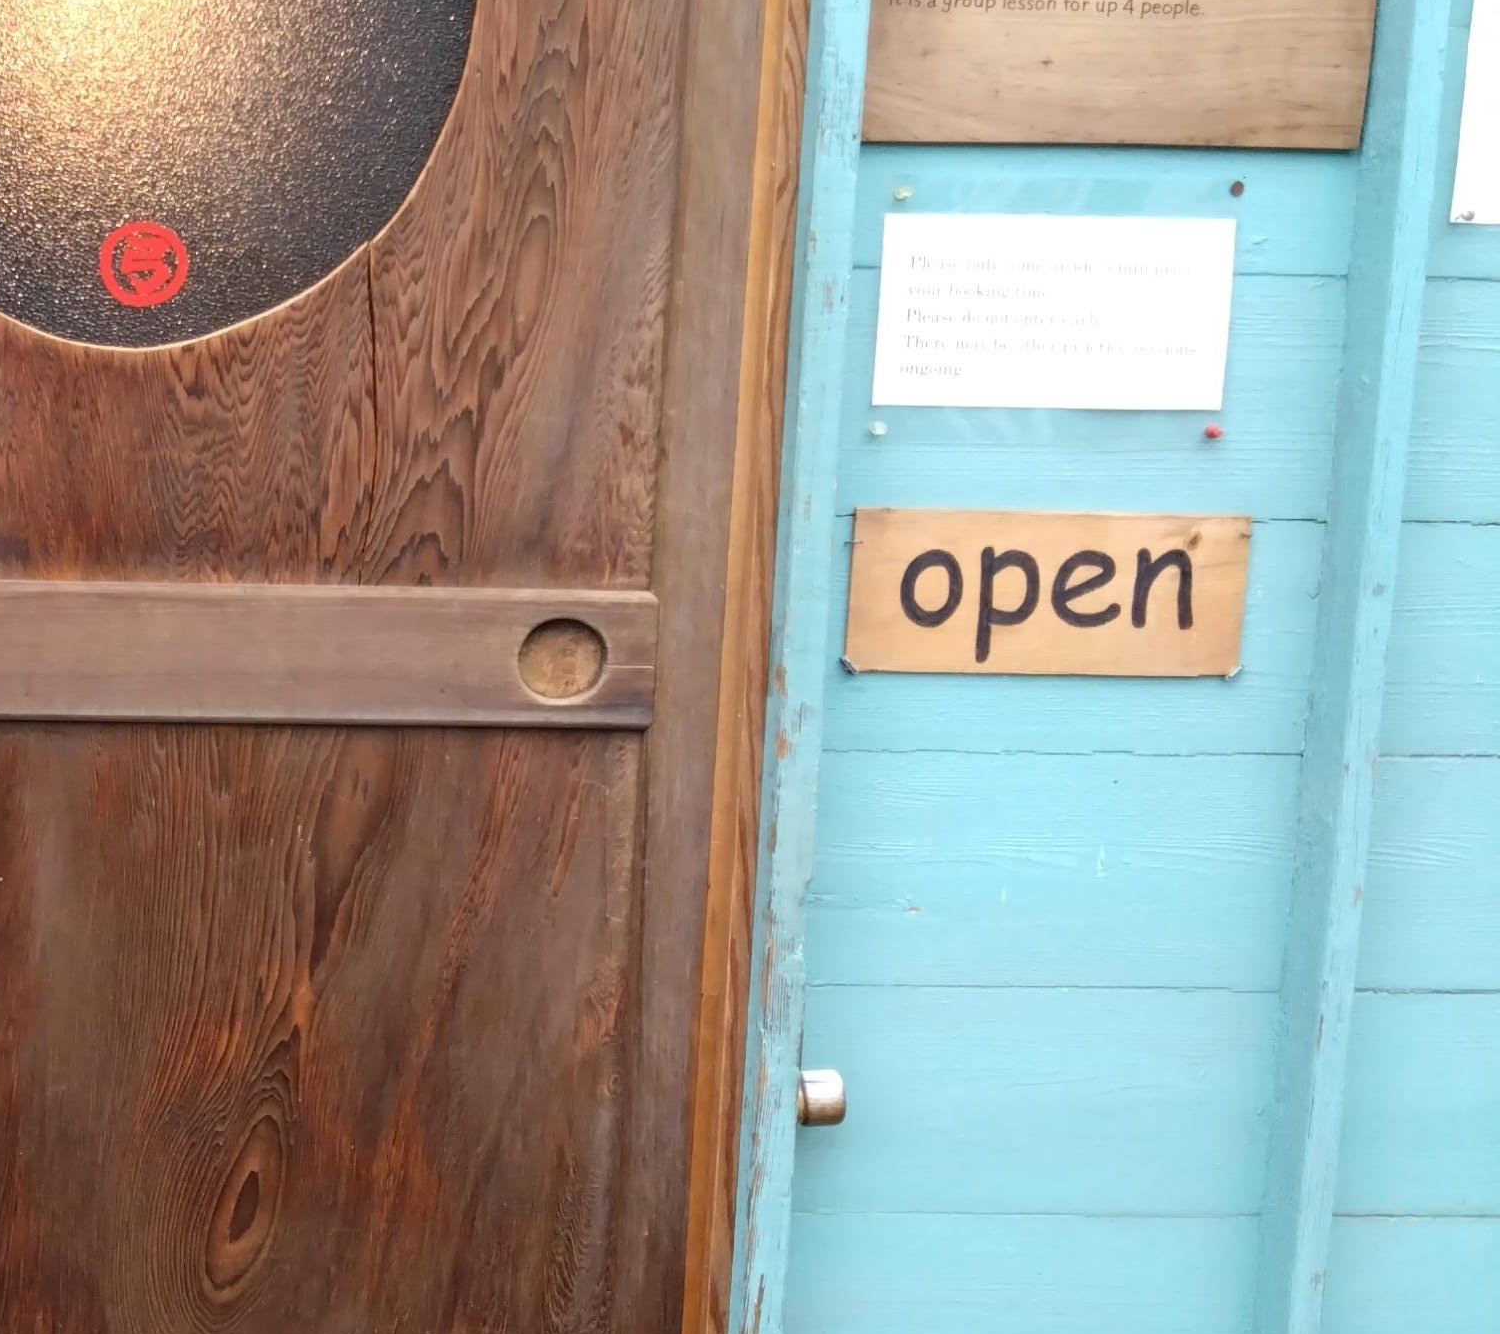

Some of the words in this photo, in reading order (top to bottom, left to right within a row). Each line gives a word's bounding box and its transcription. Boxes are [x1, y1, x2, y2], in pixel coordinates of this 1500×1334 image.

[1095, 0, 1118, 17] up
[906, 308, 953, 324] Please
[900, 546, 1194, 664] open
